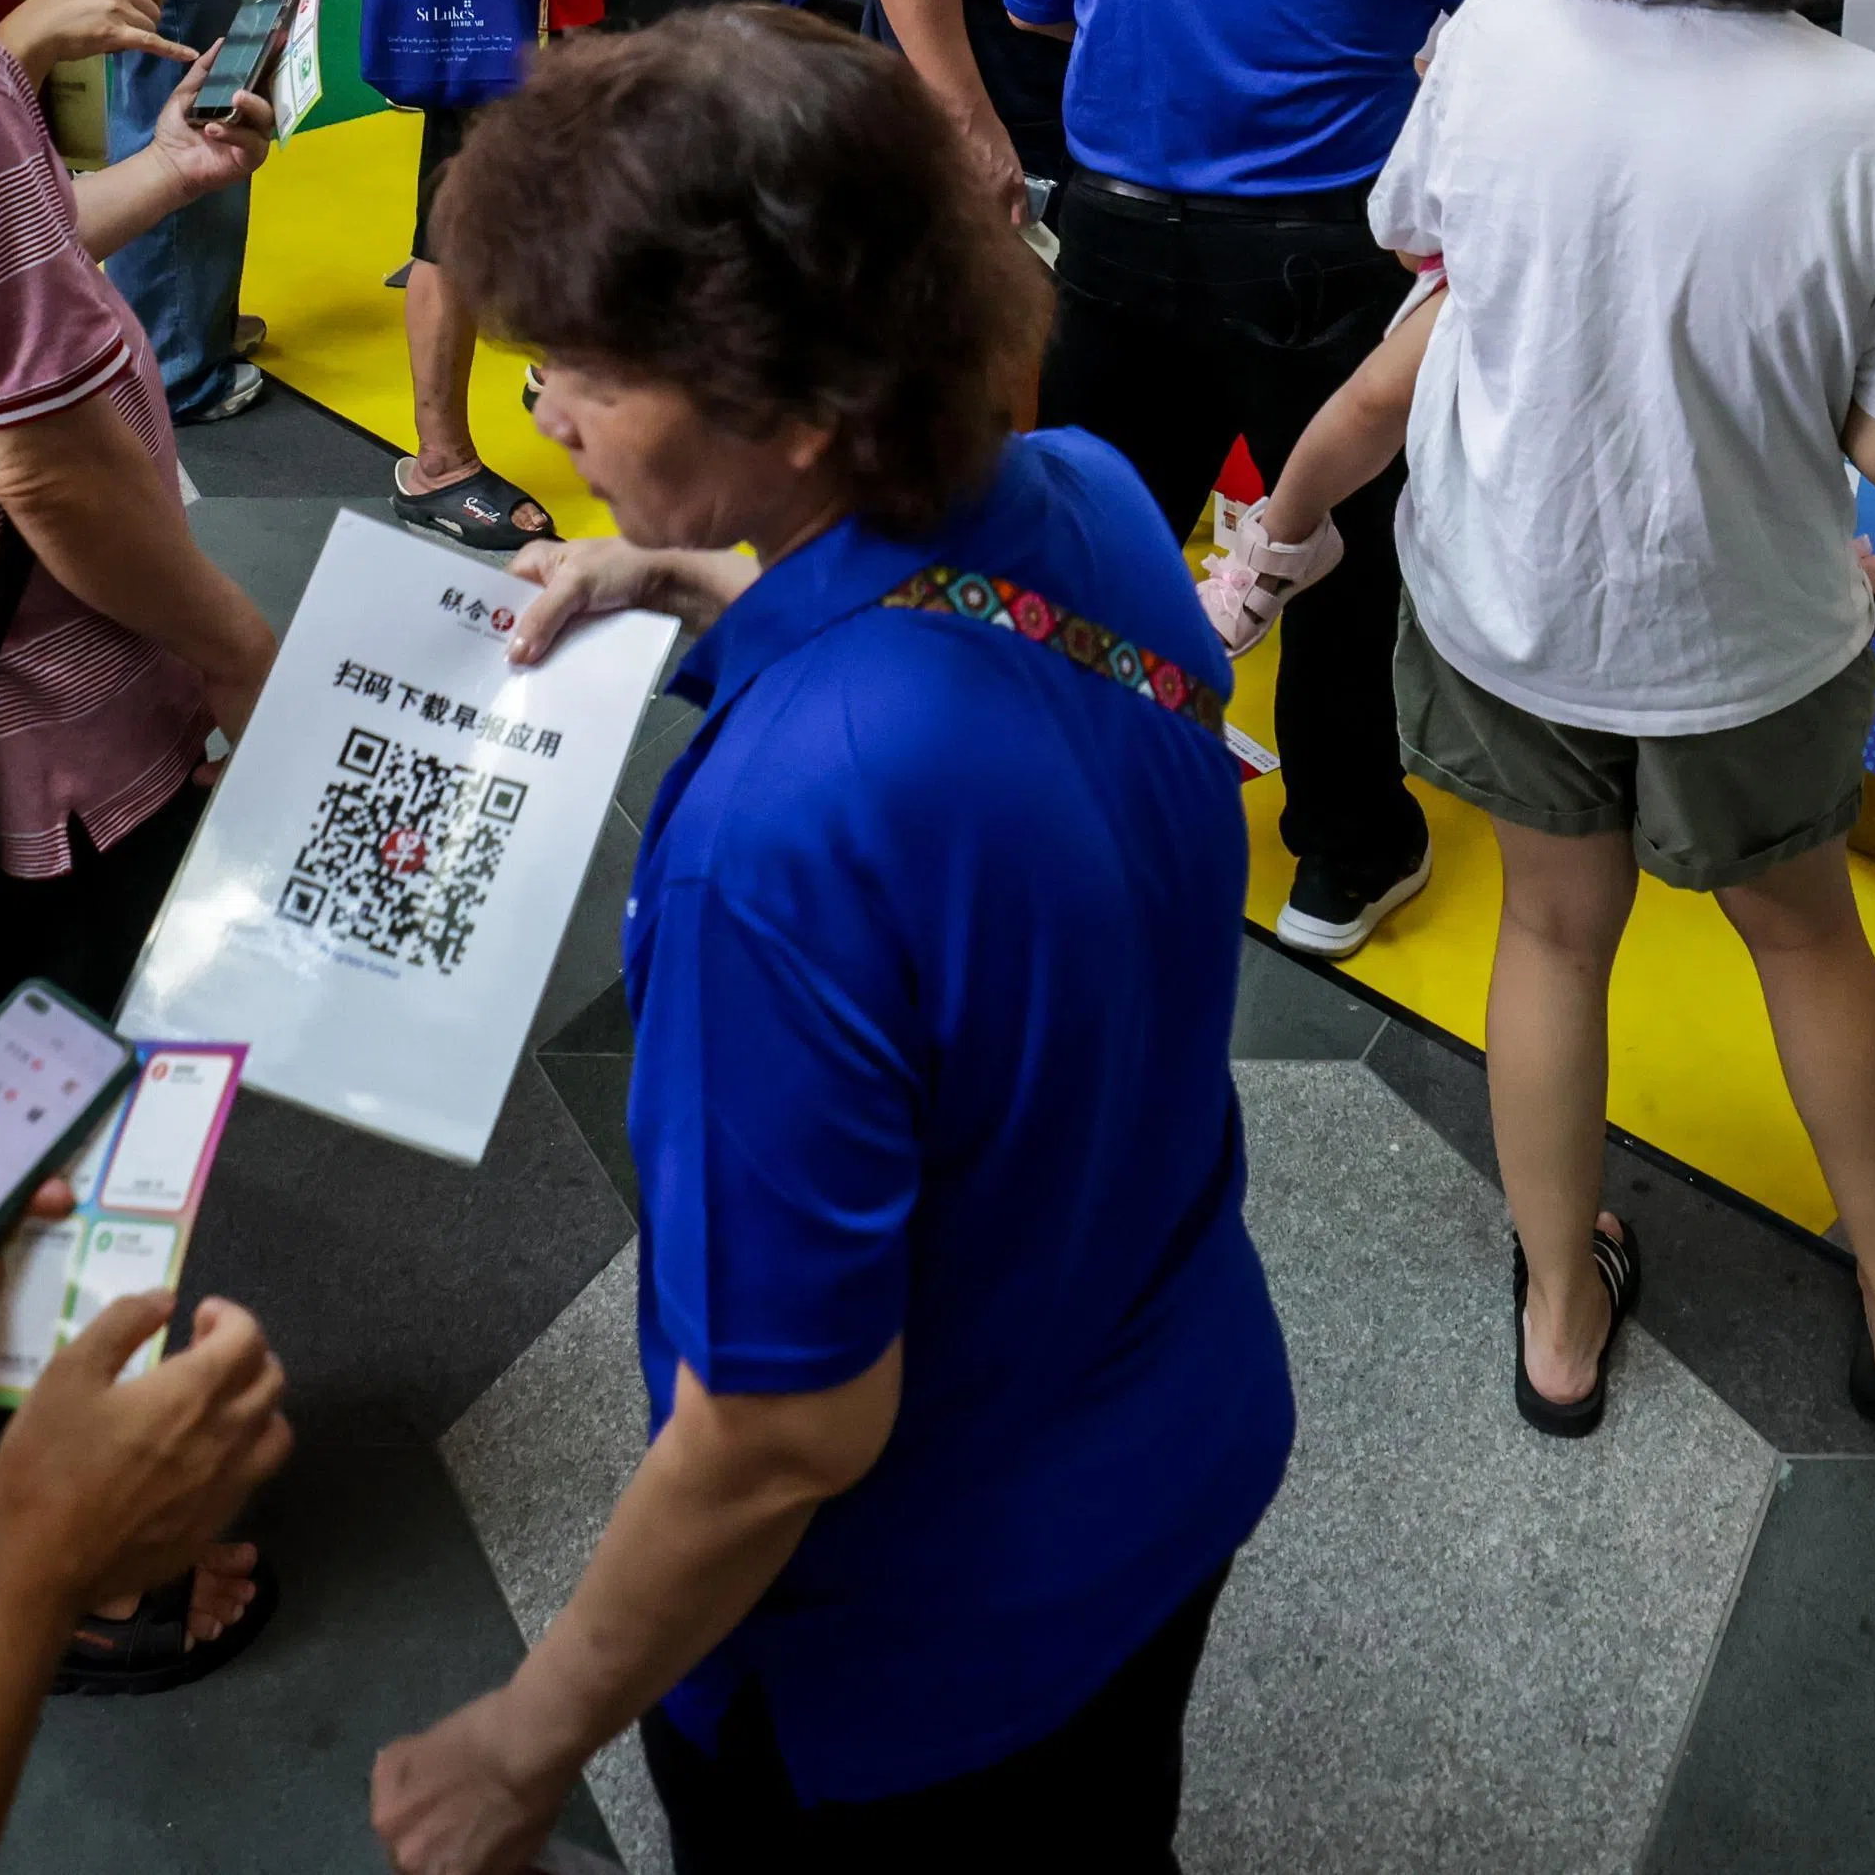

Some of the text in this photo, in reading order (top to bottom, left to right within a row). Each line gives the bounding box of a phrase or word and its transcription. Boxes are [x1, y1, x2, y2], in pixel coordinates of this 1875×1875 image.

[416, 5, 475, 22] St Luke's
[439, 586, 515, 633] 联合早
[333, 658, 564, 759] 扫码下载早报应用
[381, 827, 424, 873] 早
